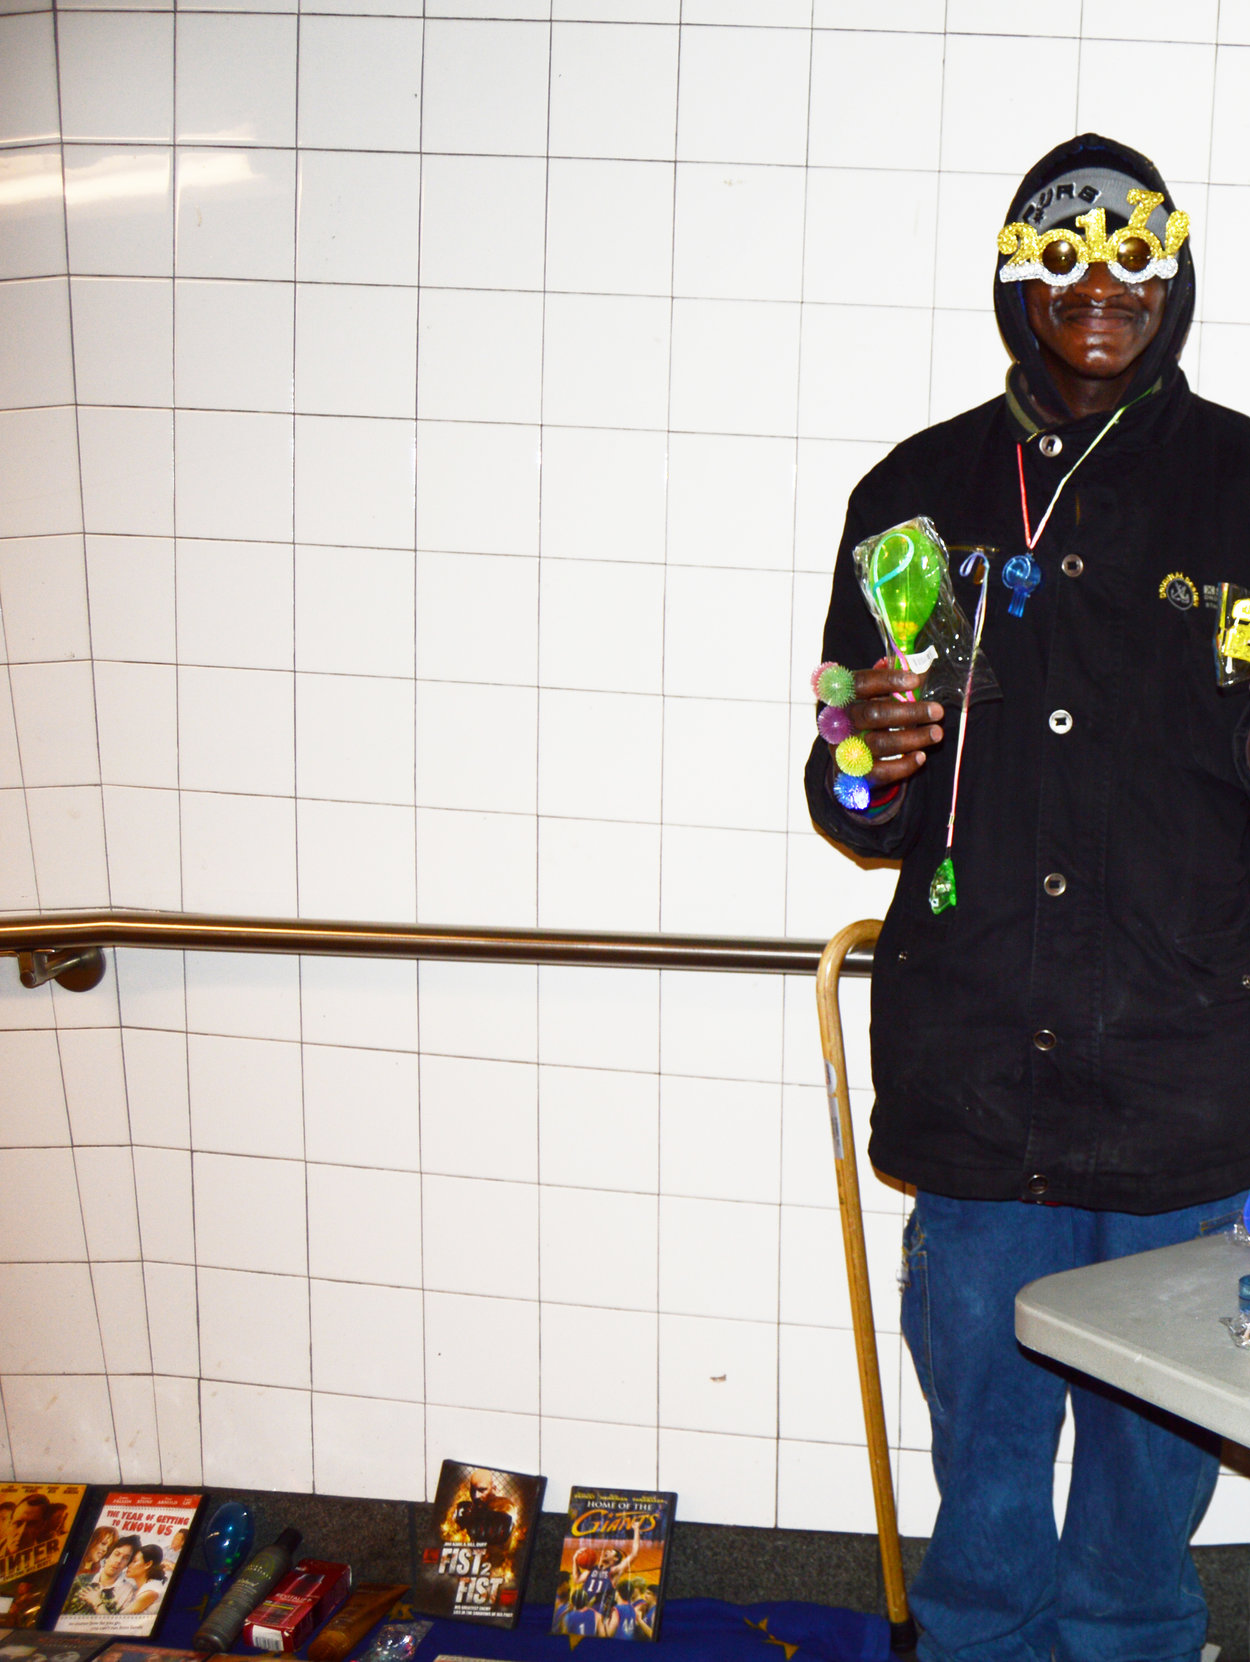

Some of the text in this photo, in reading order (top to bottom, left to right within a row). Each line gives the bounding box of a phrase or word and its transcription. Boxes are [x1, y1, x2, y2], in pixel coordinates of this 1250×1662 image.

[587, 1500, 653, 1512] HOME OF THE
[107, 1510, 121, 1518] THE
[121, 1511, 144, 1521] YEAR
[156, 1515, 190, 1526] GETTING
[121, 1521, 156, 1533] KNOW
[157, 1524, 174, 1536] US
[438, 1547, 492, 1576] FIST 2
[455, 1577, 504, 1604] FIST
[587, 1579, 603, 1593] 11
